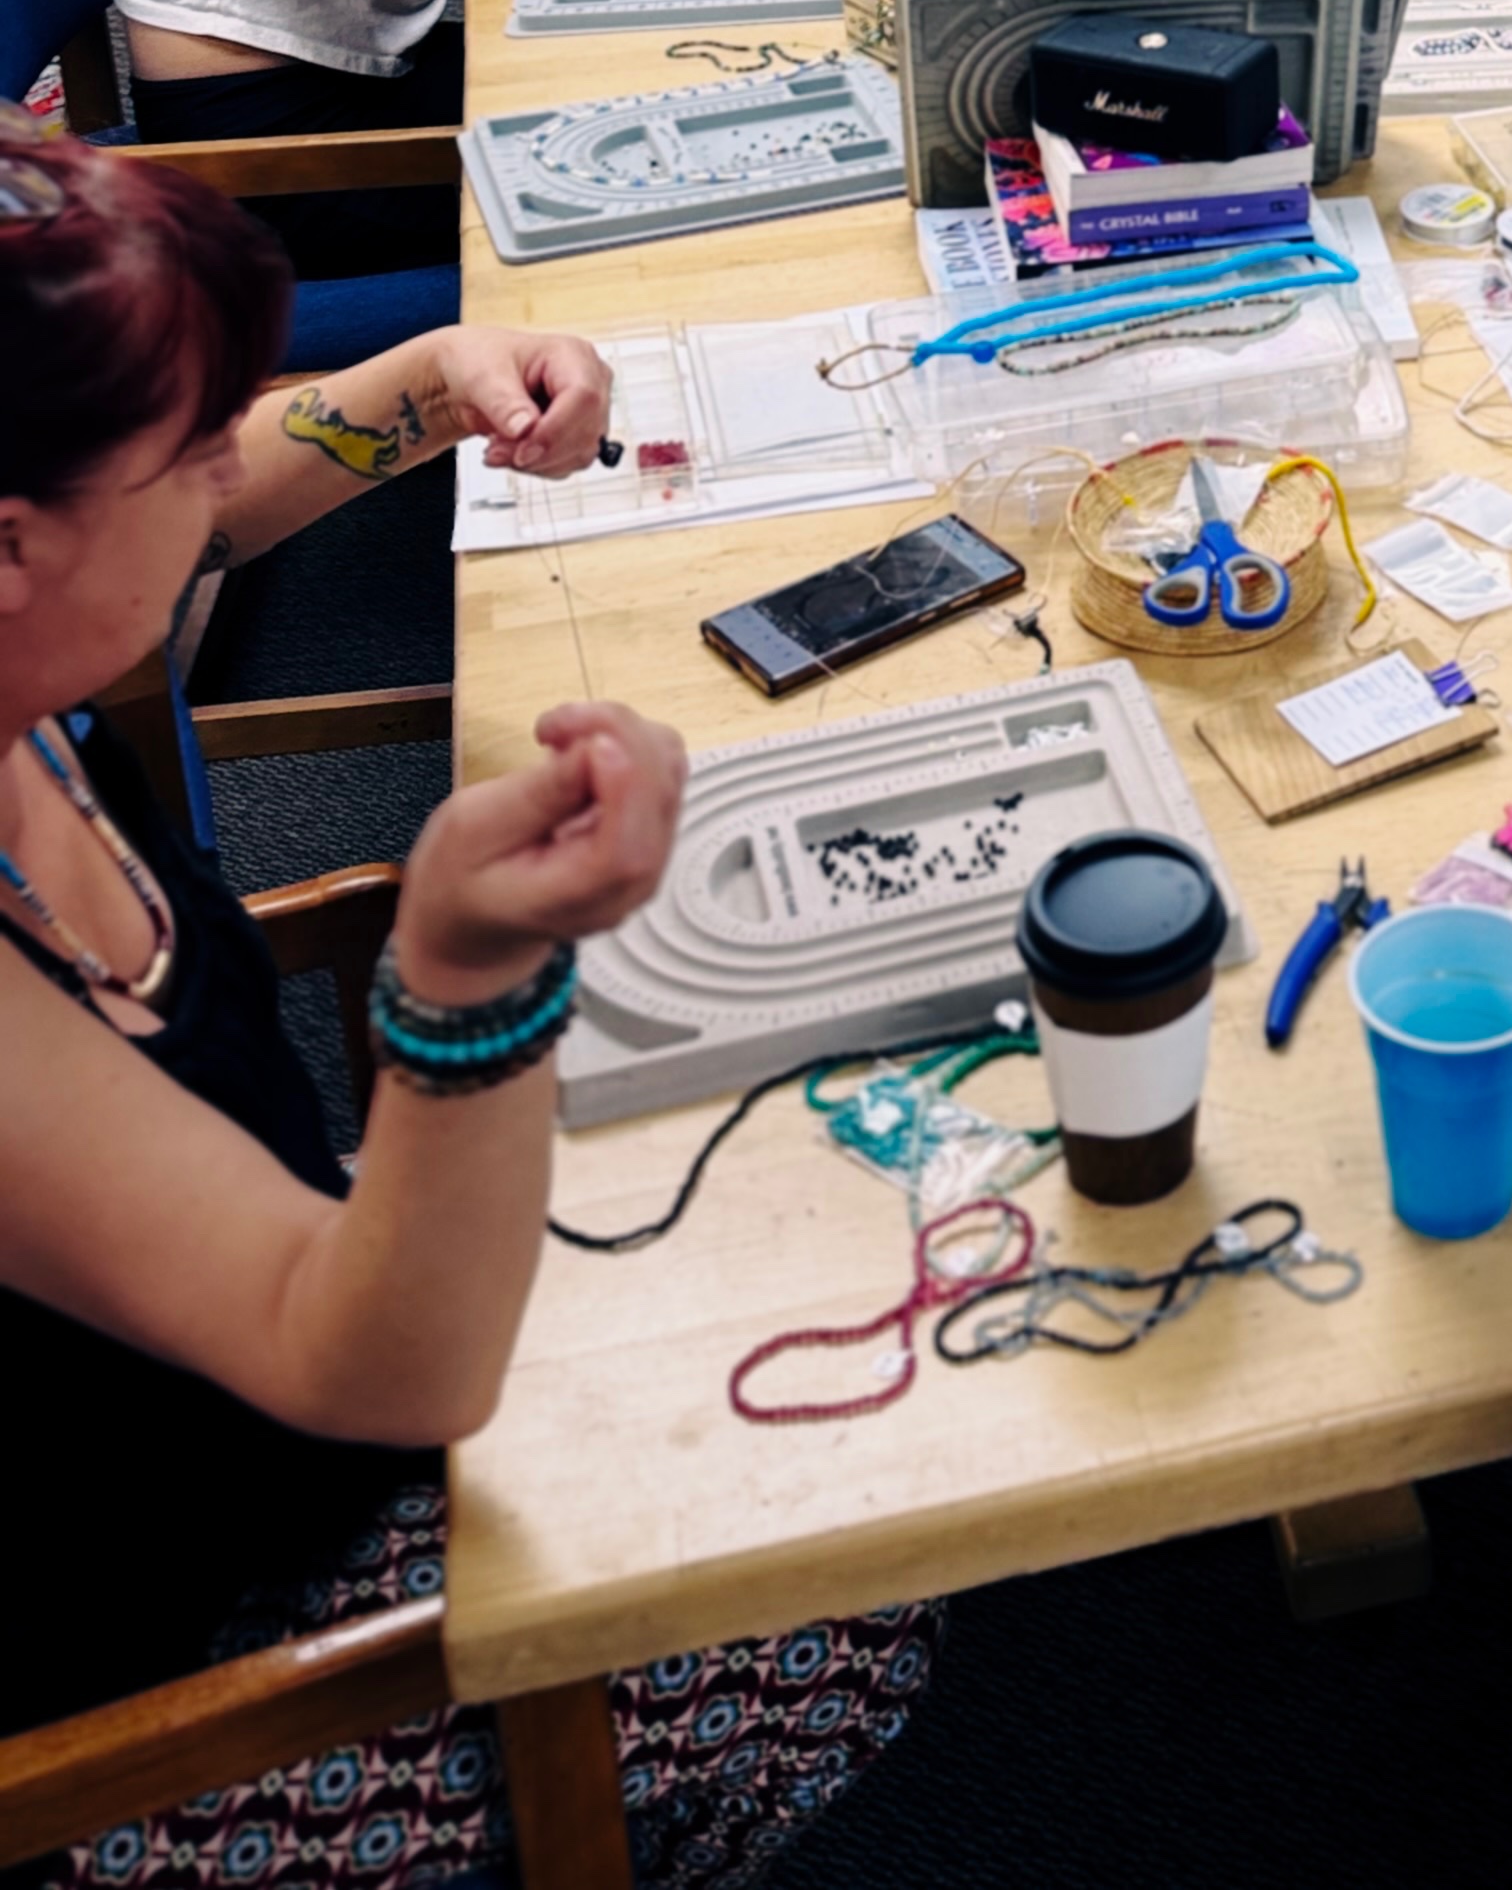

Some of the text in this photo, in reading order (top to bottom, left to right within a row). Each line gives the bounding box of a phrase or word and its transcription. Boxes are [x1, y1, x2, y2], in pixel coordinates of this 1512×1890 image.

[1084, 90, 1167, 121] Marshall
[1099, 211, 1160, 231] CRYSTAL
[1163, 208, 1199, 225] BIBLE
[934, 220, 980, 274] BOOK
